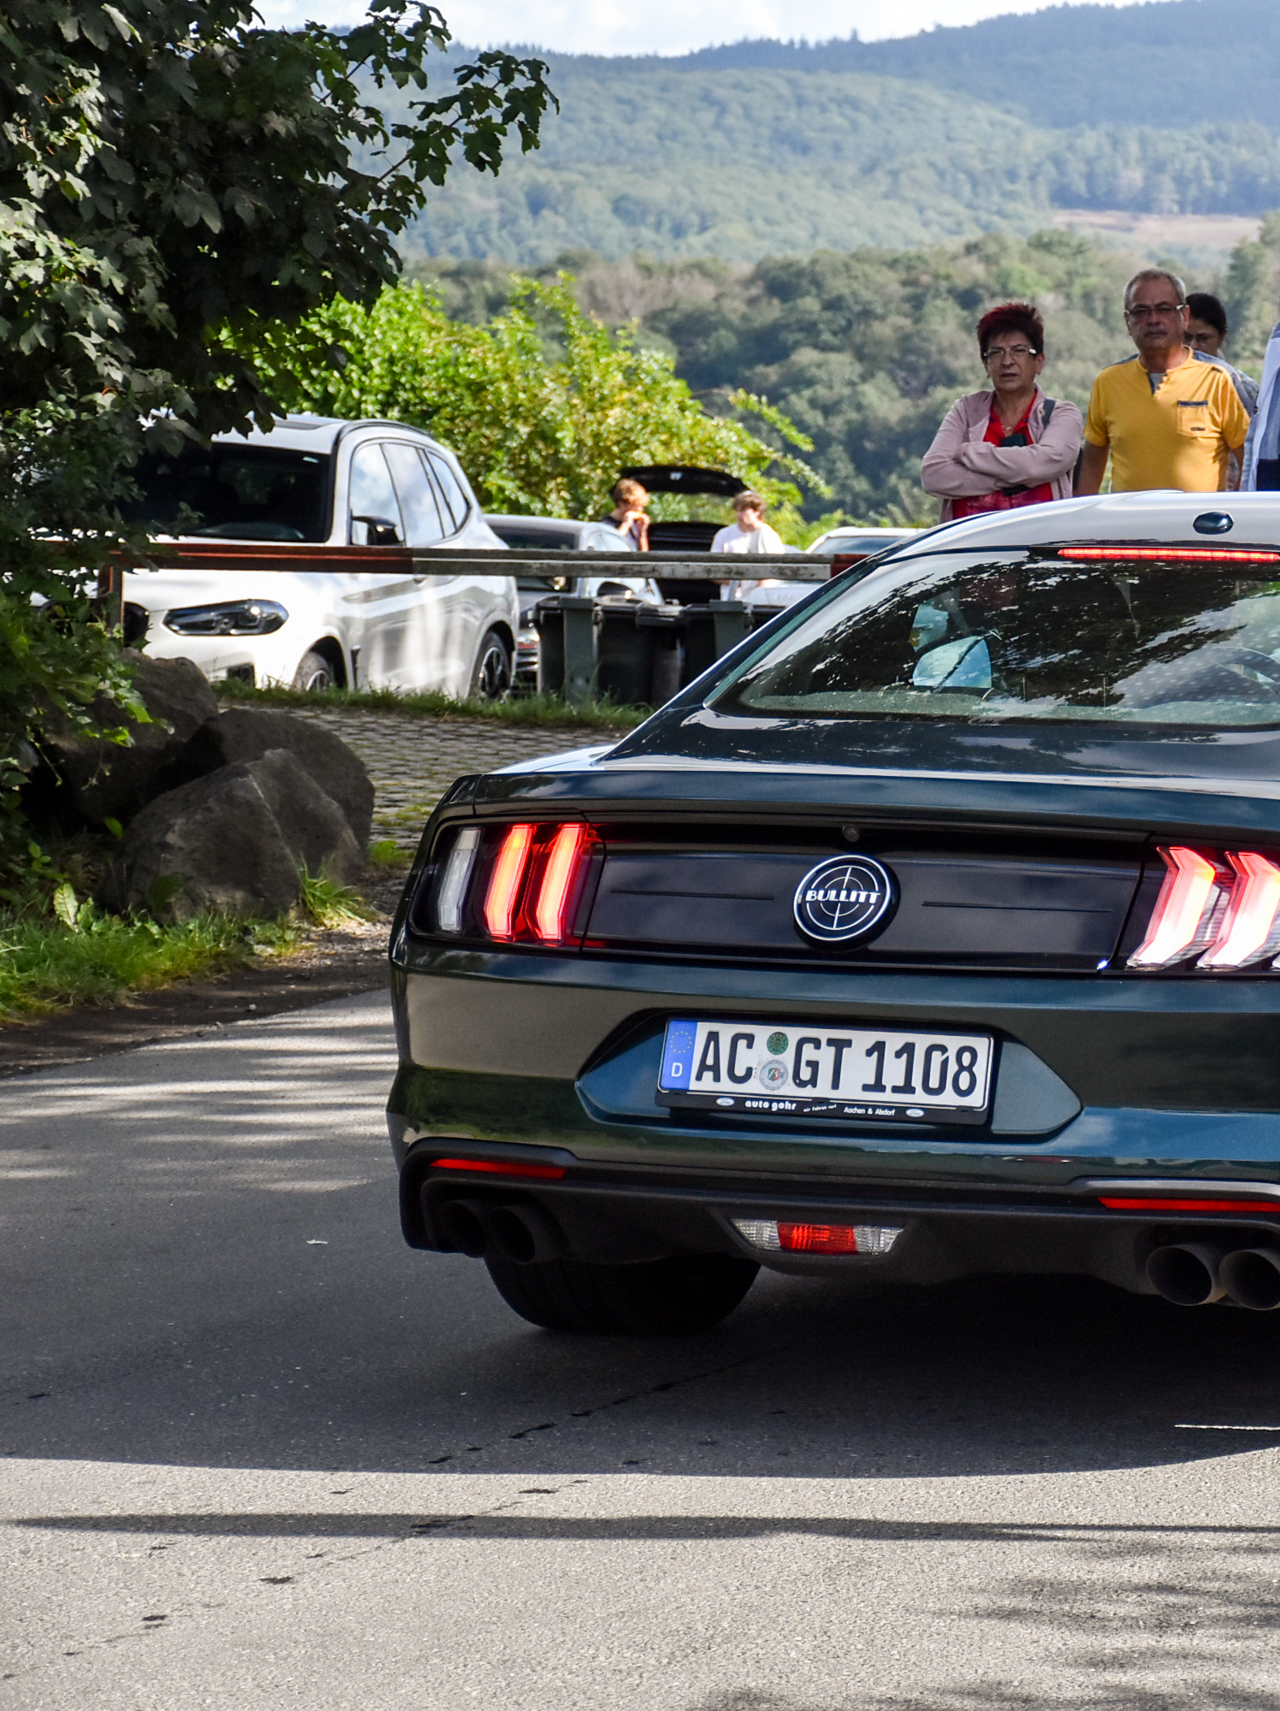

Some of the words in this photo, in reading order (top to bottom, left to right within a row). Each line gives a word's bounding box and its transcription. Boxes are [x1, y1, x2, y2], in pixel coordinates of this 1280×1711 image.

[805, 889, 881, 904] BULLITT
[671, 1062, 683, 1078] D
[695, 1030, 755, 1085] AC
[792, 1037, 853, 1091] GT
[861, 1040, 979, 1098] 1108
[745, 1100, 770, 1109] auto
[771, 1101, 797, 1112] gohr
